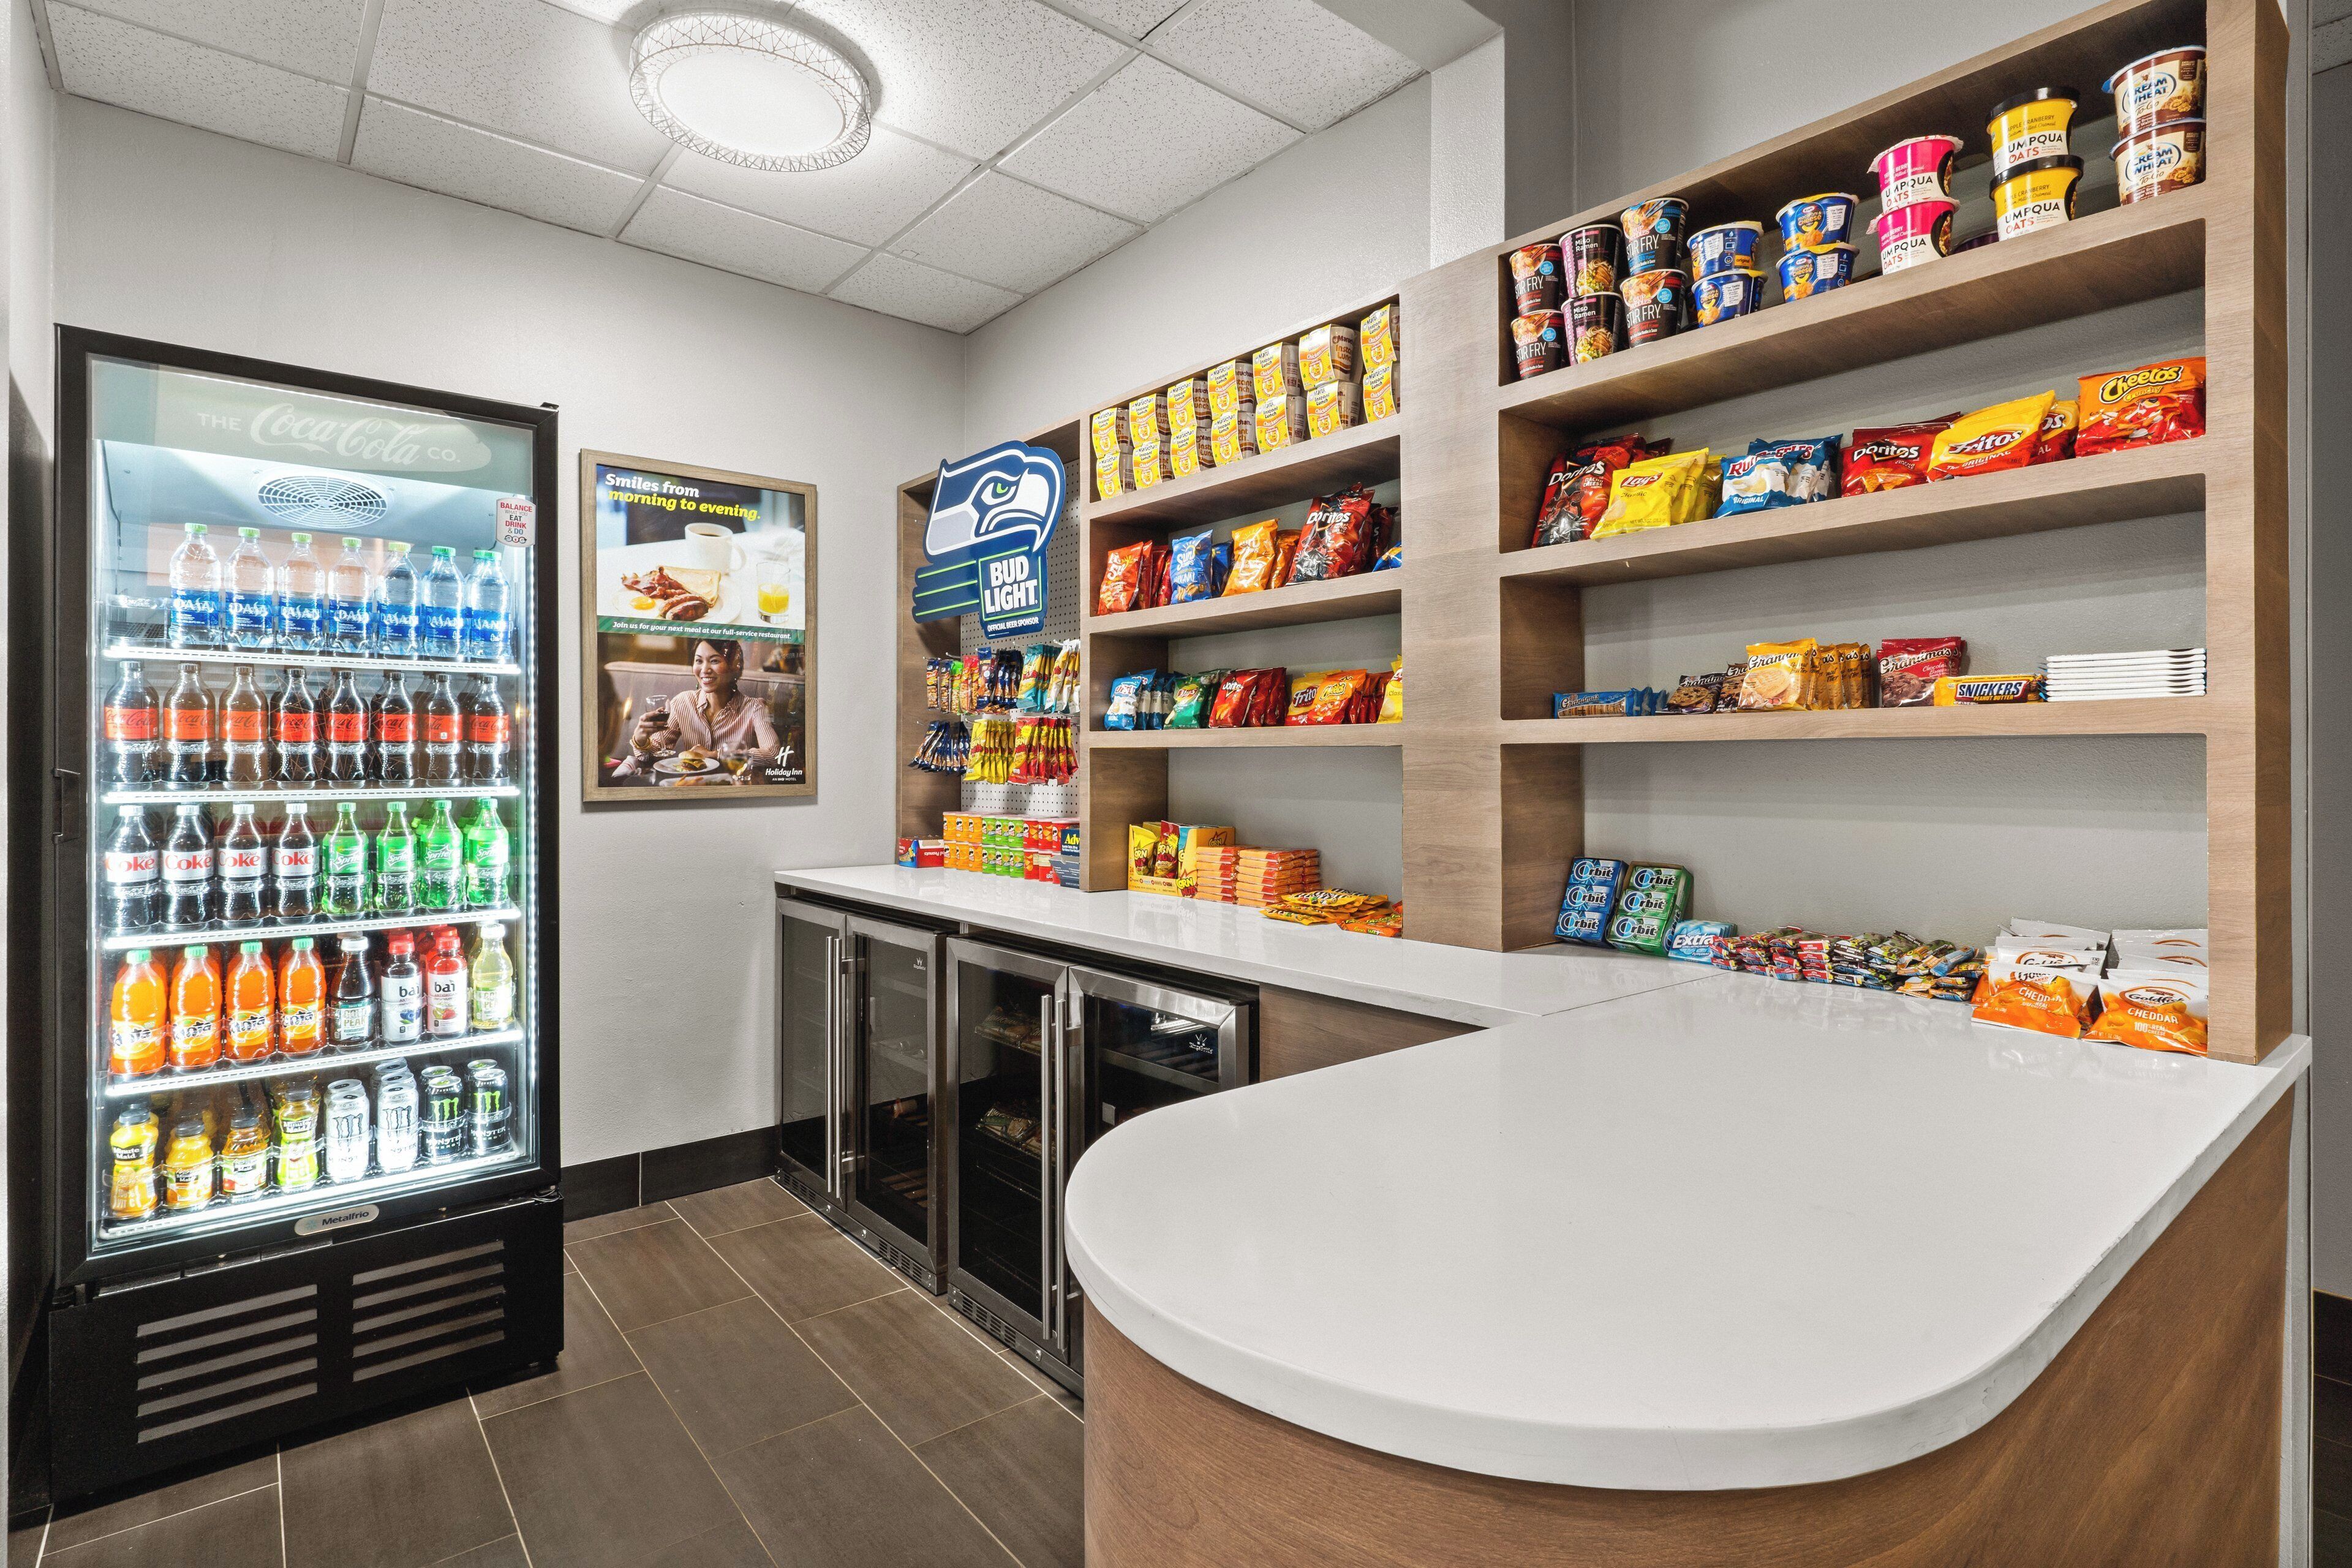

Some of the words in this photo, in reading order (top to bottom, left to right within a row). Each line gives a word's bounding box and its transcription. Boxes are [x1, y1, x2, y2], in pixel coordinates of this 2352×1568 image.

[2008, 133, 2063, 153] UMPQUA
[2009, 146, 2039, 164] OATS
[2133, 157, 2173, 175] WHEAT
[2139, 170, 2164, 185] To-Go
[1887, 190, 1909, 207] OATS
[2005, 202, 2060, 224] UMPQUA
[2006, 217, 2034, 235] OATS
[1575, 238, 1591, 246] Miso
[1575, 242, 1598, 252] Ramen
[1626, 240, 1639, 260] STIR
[1640, 234, 1659, 252] FRY
[1883, 237, 1926, 260] UMPQUA
[1883, 254, 1902, 270] OATS
[1515, 281, 1526, 299] STIR
[1527, 275, 1543, 292] FRY
[1574, 310, 1596, 320] Ramen
[1627, 308, 1640, 328] STIR
[1642, 304, 1661, 320] FRY
[1369, 325, 1381, 334] Lunch
[1516, 345, 1529, 364] STIR
[1529, 342, 1546, 358] FRY
[1369, 366, 1390, 380] Maruchan
[1370, 375, 1384, 386] Instant
[2100, 366, 2184, 404] Cheetos
[1314, 393, 1330, 402] Instant
[2123, 386, 2163, 402] Crunchy
[1263, 406, 1278, 415] Instant
[197, 412, 241, 431] THE
[427, 447, 460, 463] CO.
[1949, 430, 2023, 454] Fritos
[1853, 445, 1921, 462] Doritos
[1961, 451, 2011, 467] ORIGINAL
[1548, 461, 1605, 486] Doritos
[605, 473, 658, 493] Smiles
[662, 481, 699, 497] from
[500, 502, 532, 513] BALANCE
[608, 490, 677, 511] morning
[680, 499, 696, 511] to
[699, 503, 760, 521] evening.
[1733, 496, 1765, 505] ORIGINAL
[1306, 511, 1351, 525] Doritos
[989, 556, 1030, 587] BUD
[984, 579, 1038, 614] LIGHT
[612, 621, 628, 630] Join
[650, 624, 666, 633] your
[987, 622, 1006, 632] OFFICIAL
[1006, 620, 1017, 629] BEER
[1017, 617, 1039, 627] SPONSOR
[1294, 687, 1317, 707] Frito
[1958, 682, 2021, 696] SNICKERS
[1561, 693, 1599, 708] Grandma's
[766, 767, 791, 777] Holiday
[1065, 833, 1080, 845] Adv
[1208, 838, 1223, 846] CORN
[165, 853, 212, 870] Coke
[218, 853, 260, 869] Coke
[272, 850, 314, 865] Coke
[1574, 861, 1613, 881] Orbit
[1634, 869, 1675, 889] Orbit
[1176, 877, 1194, 889] CORN
[1567, 886, 1607, 907] Orbit
[1624, 891, 1666, 912] Orbit
[1560, 911, 1599, 932] Orbit
[1615, 917, 1658, 938] Orbit
[1673, 933, 1713, 948] Extra
[434, 980, 456, 992] bai
[2128, 1008, 2178, 1024] CHEDDAR
[322, 1210, 369, 1226] Metalfrio
